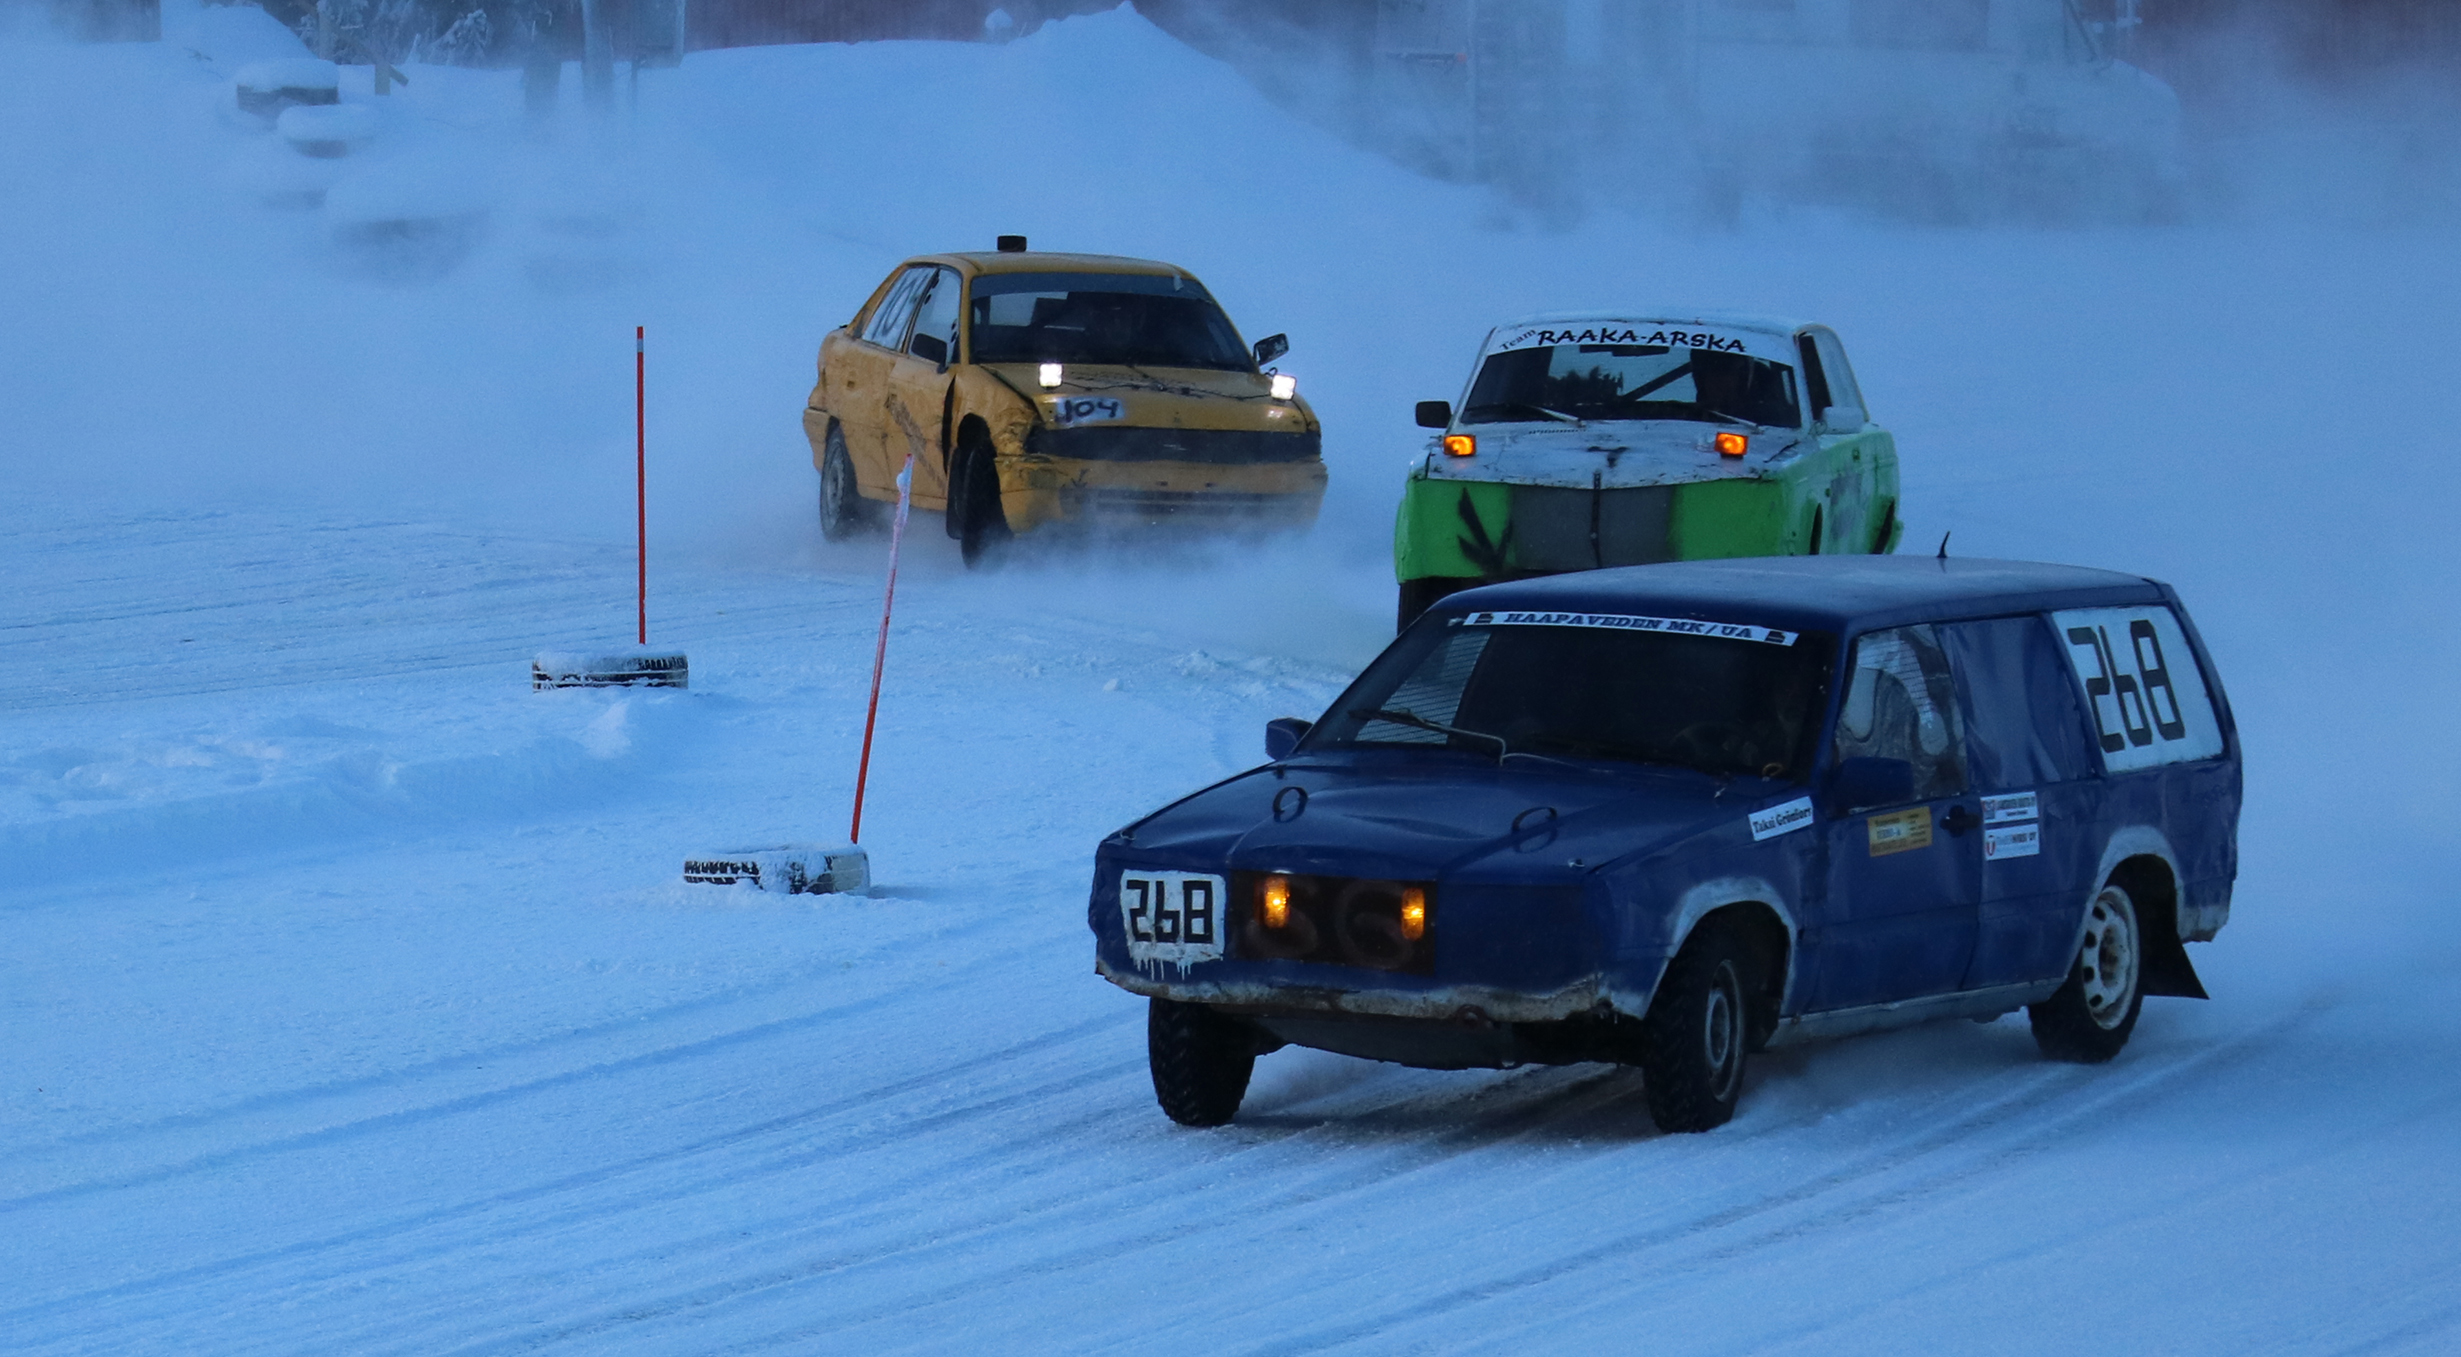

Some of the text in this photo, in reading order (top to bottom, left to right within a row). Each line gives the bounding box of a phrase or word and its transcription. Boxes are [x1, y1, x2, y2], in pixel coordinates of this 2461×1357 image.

[1500, 327, 1747, 352] Team RAAKA-ARSKA
[1054, 399, 1119, 423] 104
[1503, 612, 1661, 630] HAAPAVEDEN
[2066, 619, 2186, 754] 268
[1126, 879, 1213, 943] 268
